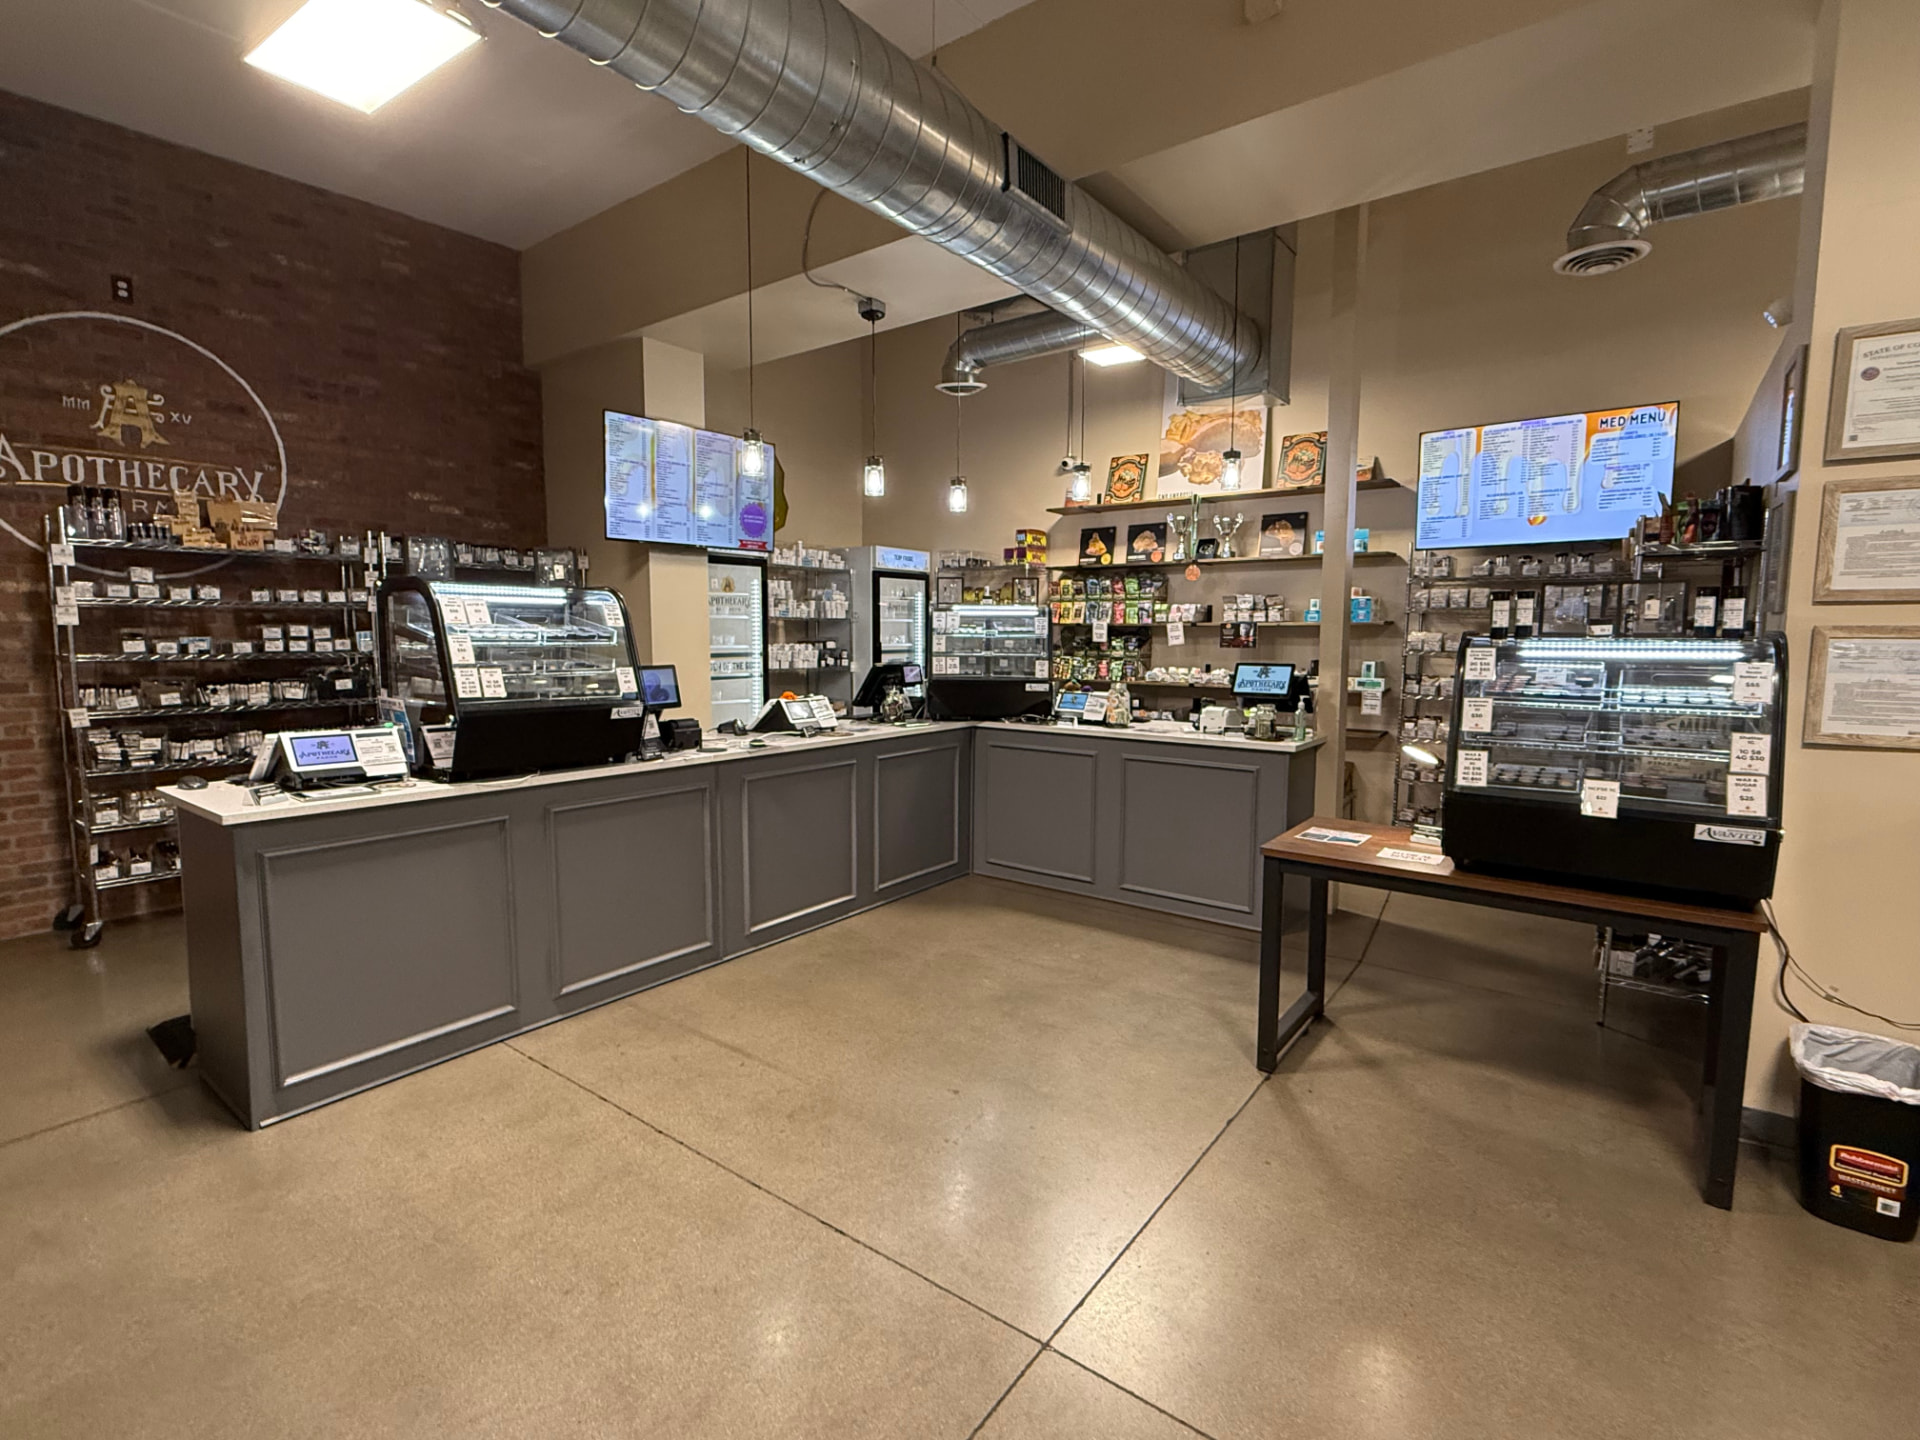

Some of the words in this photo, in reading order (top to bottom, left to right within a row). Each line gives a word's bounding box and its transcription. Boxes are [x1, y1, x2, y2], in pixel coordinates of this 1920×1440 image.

[1863, 346, 1891, 358] STATE
[1599, 416, 1626, 429] MED
[1629, 411, 1666, 426] MENU
[1237, 678, 1287, 690] APOTHECARY
[299, 749, 351, 759] APOTHECARY
